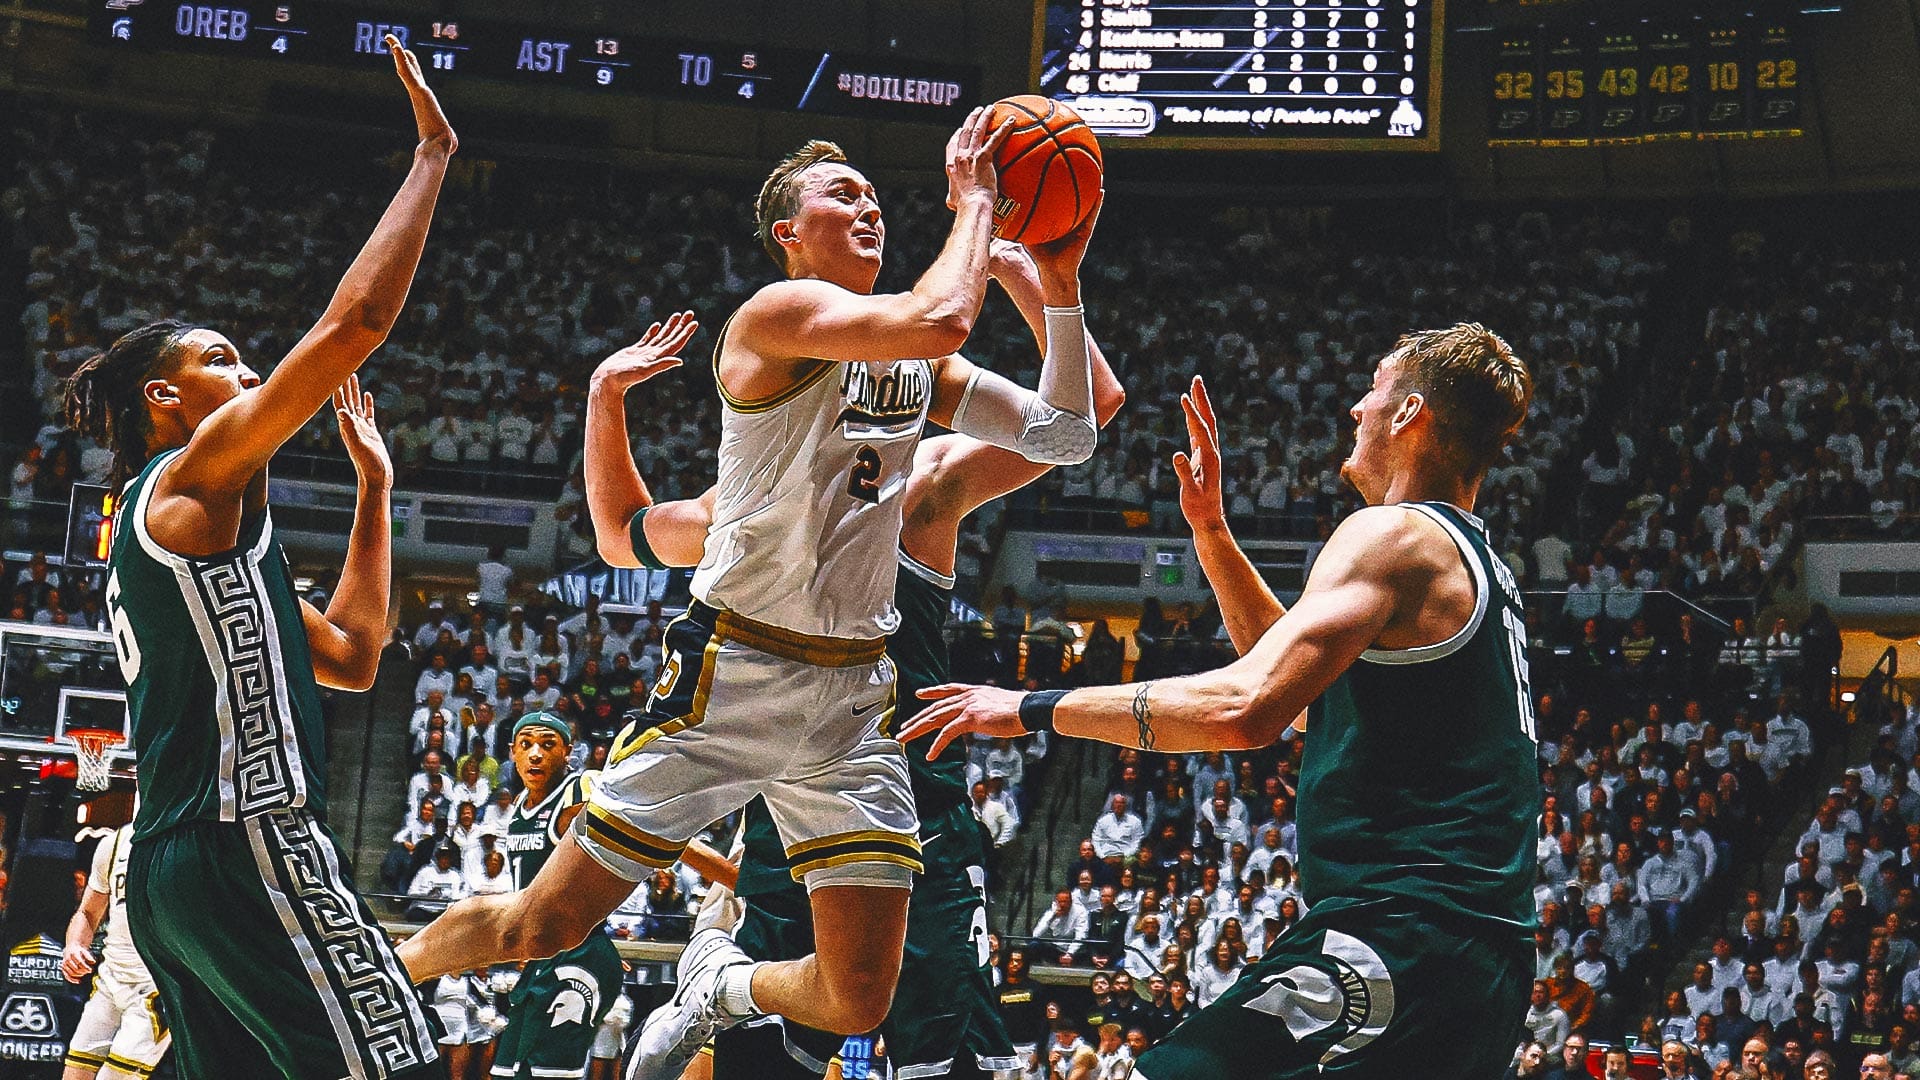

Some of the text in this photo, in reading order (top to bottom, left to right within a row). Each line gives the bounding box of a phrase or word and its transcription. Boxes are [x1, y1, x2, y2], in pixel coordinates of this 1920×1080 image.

[176, 5, 247, 40] OREB
[275, 7, 290, 22] 5
[1081, 9, 1415, 29] 3 Smith 2 3 7 0 1
[355, 23, 409, 55] REB
[432, 22, 458, 40] 14
[1080, 30, 1093, 48] 4
[1291, 31, 1305, 48] 3
[1326, 31, 1340, 48] 2
[1366, 31, 1376, 48] 1
[1404, 32, 1414, 49] 1
[272, 36, 288, 54] 4
[595, 39, 619, 55] 13
[433, 51, 456, 70] 11
[516, 40, 570, 73] AST
[741, 53, 757, 69] 5
[1069, 51, 1413, 72] 24 Harris 2 2 1 0 1
[596, 67, 613, 85] 9
[679, 54, 712, 86] TO
[1650, 65, 1690, 93] 42
[1708, 62, 1738, 91] 10
[1757, 60, 1797, 88] 22
[738, 81, 755, 99] 4
[837, 74, 961, 106] #BOILERUP
[1288, 77, 1303, 94] 4
[1324, 77, 1339, 95] 0
[1362, 77, 1377, 95] 0
[1400, 77, 1414, 95] 0
[1495, 72, 1533, 99] 32
[1547, 70, 1584, 98] 35
[1599, 68, 1638, 96] 43
[1252, 107, 1273, 123] of
[1273, 107, 1331, 123] Purdue
[847, 444, 882, 504] 2
